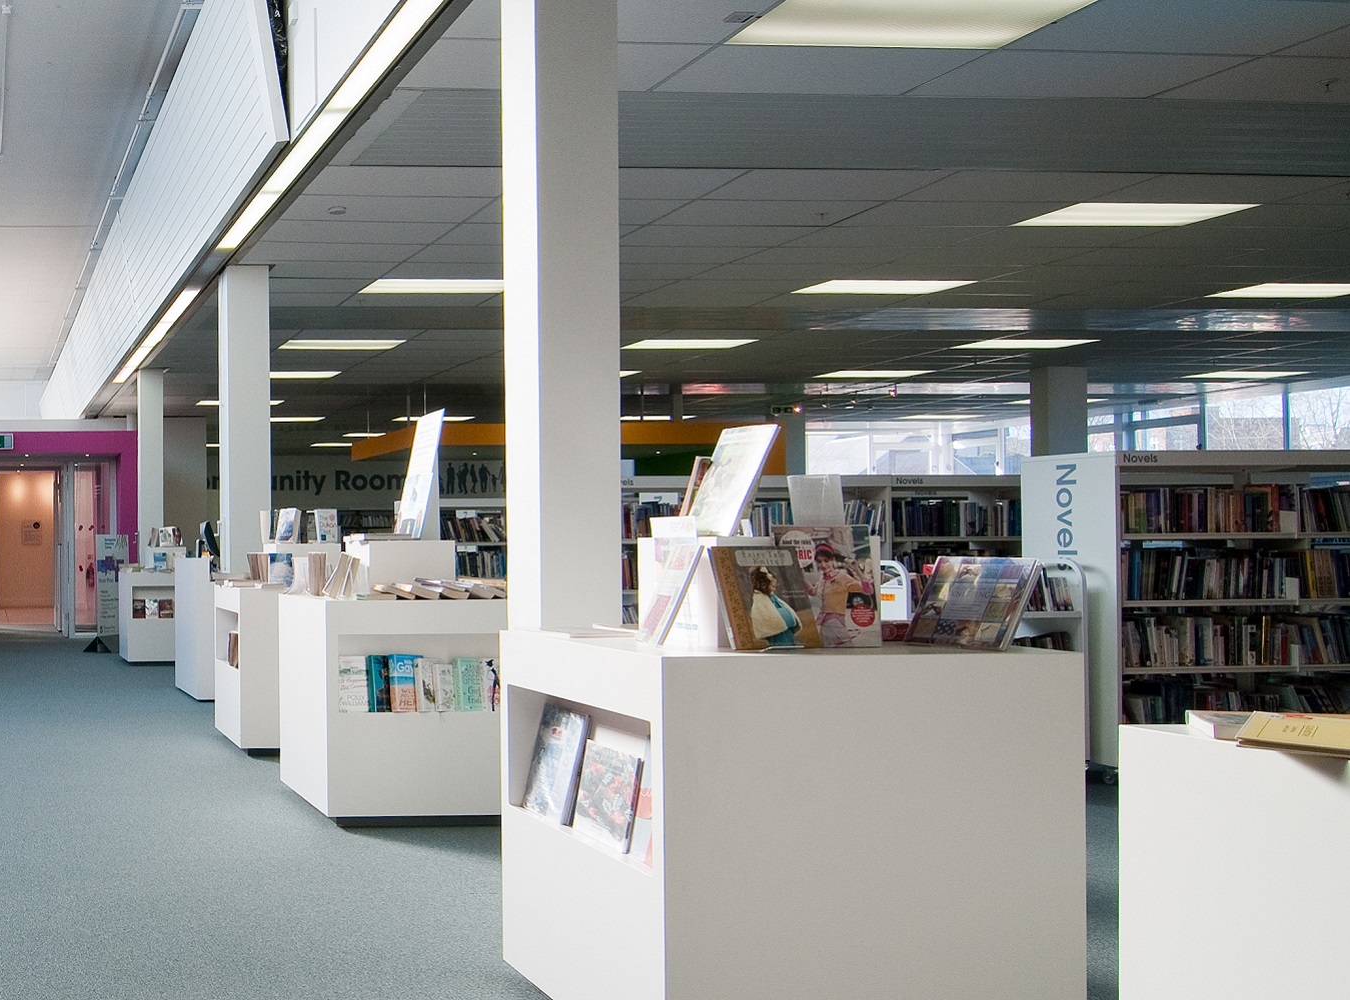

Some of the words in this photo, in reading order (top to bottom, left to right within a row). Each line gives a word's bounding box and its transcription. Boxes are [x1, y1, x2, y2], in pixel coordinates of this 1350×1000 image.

[1123, 453, 1158, 463] Novels
[896, 477, 924, 485] Novels
[797, 549, 813, 560] RIC
[396, 662, 414, 676] Gay
